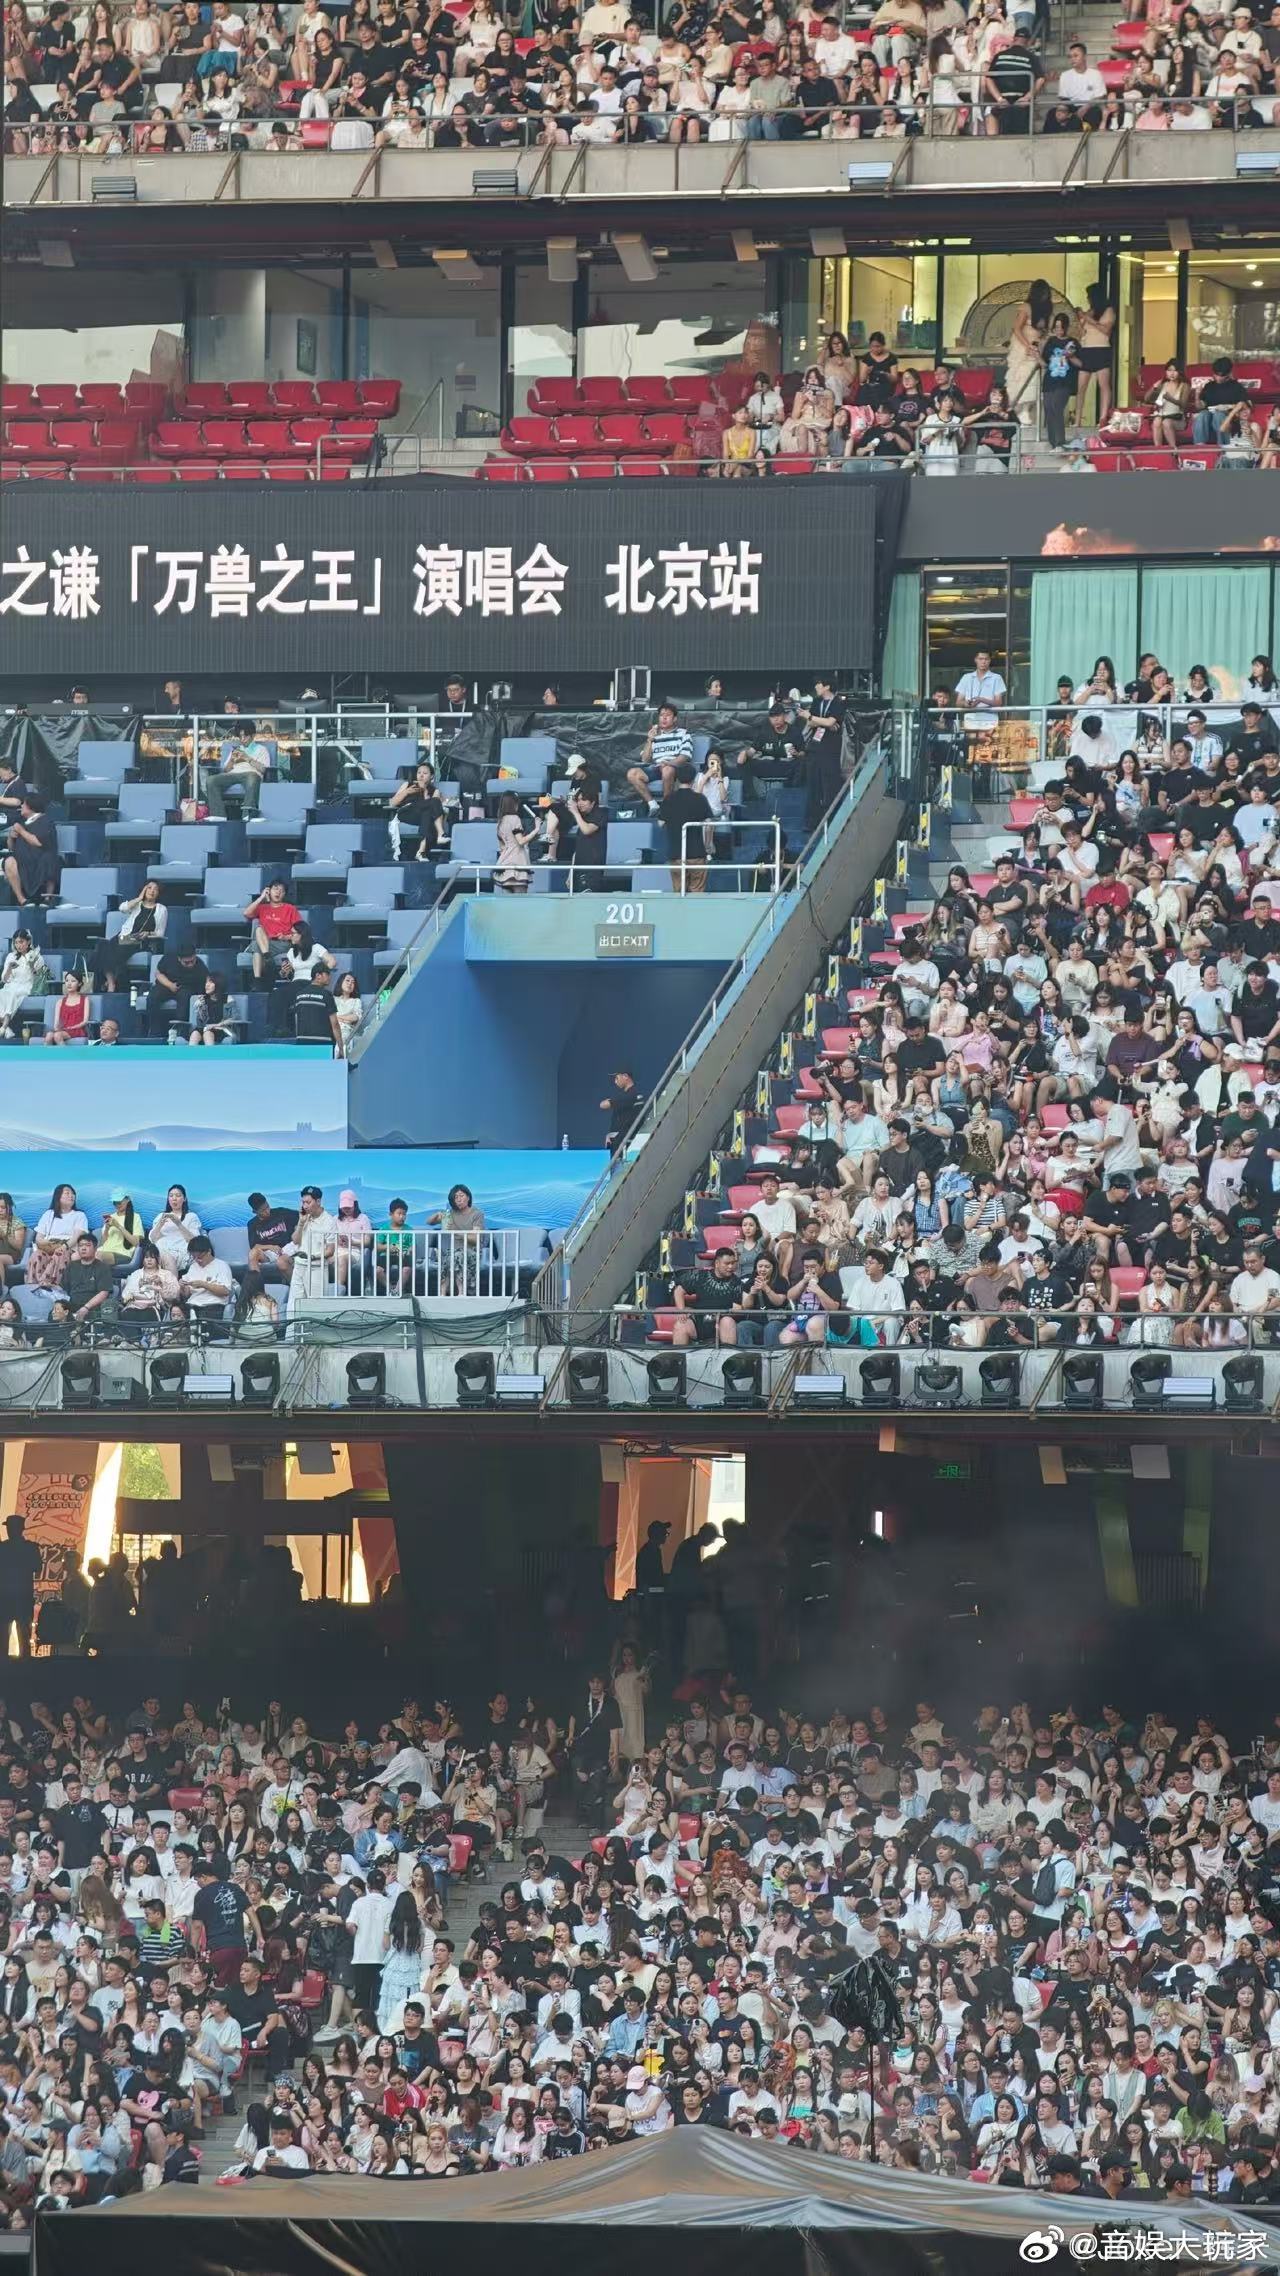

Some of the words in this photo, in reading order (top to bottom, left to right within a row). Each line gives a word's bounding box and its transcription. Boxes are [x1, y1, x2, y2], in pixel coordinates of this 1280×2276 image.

[0, 542, 569, 620] 之谦「万兽之王」演唱会
[604, 540, 763, 616] 北京站
[606, 903, 643, 924] 201
[599, 935, 621, 947] 出口
[623, 935, 649, 947] EXIT
